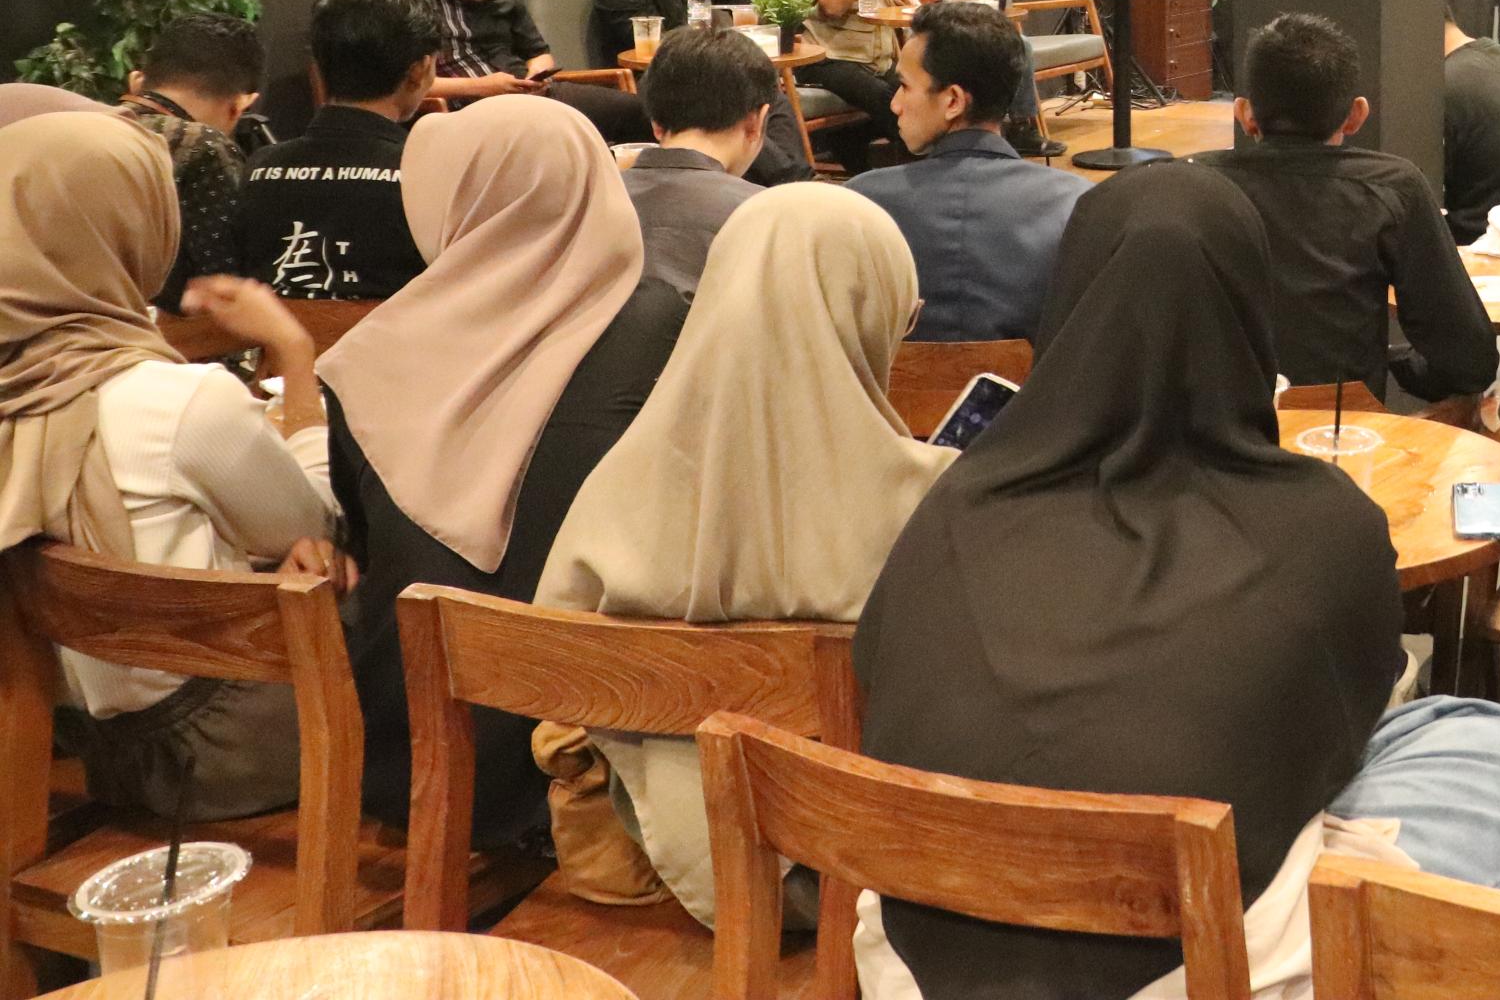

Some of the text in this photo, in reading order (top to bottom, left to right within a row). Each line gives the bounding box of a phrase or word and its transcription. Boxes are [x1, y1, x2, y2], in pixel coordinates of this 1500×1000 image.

[250, 167, 266, 181] IT
[265, 167, 283, 180] IS
[285, 167, 321, 180] NOT
[322, 167, 334, 180] A
